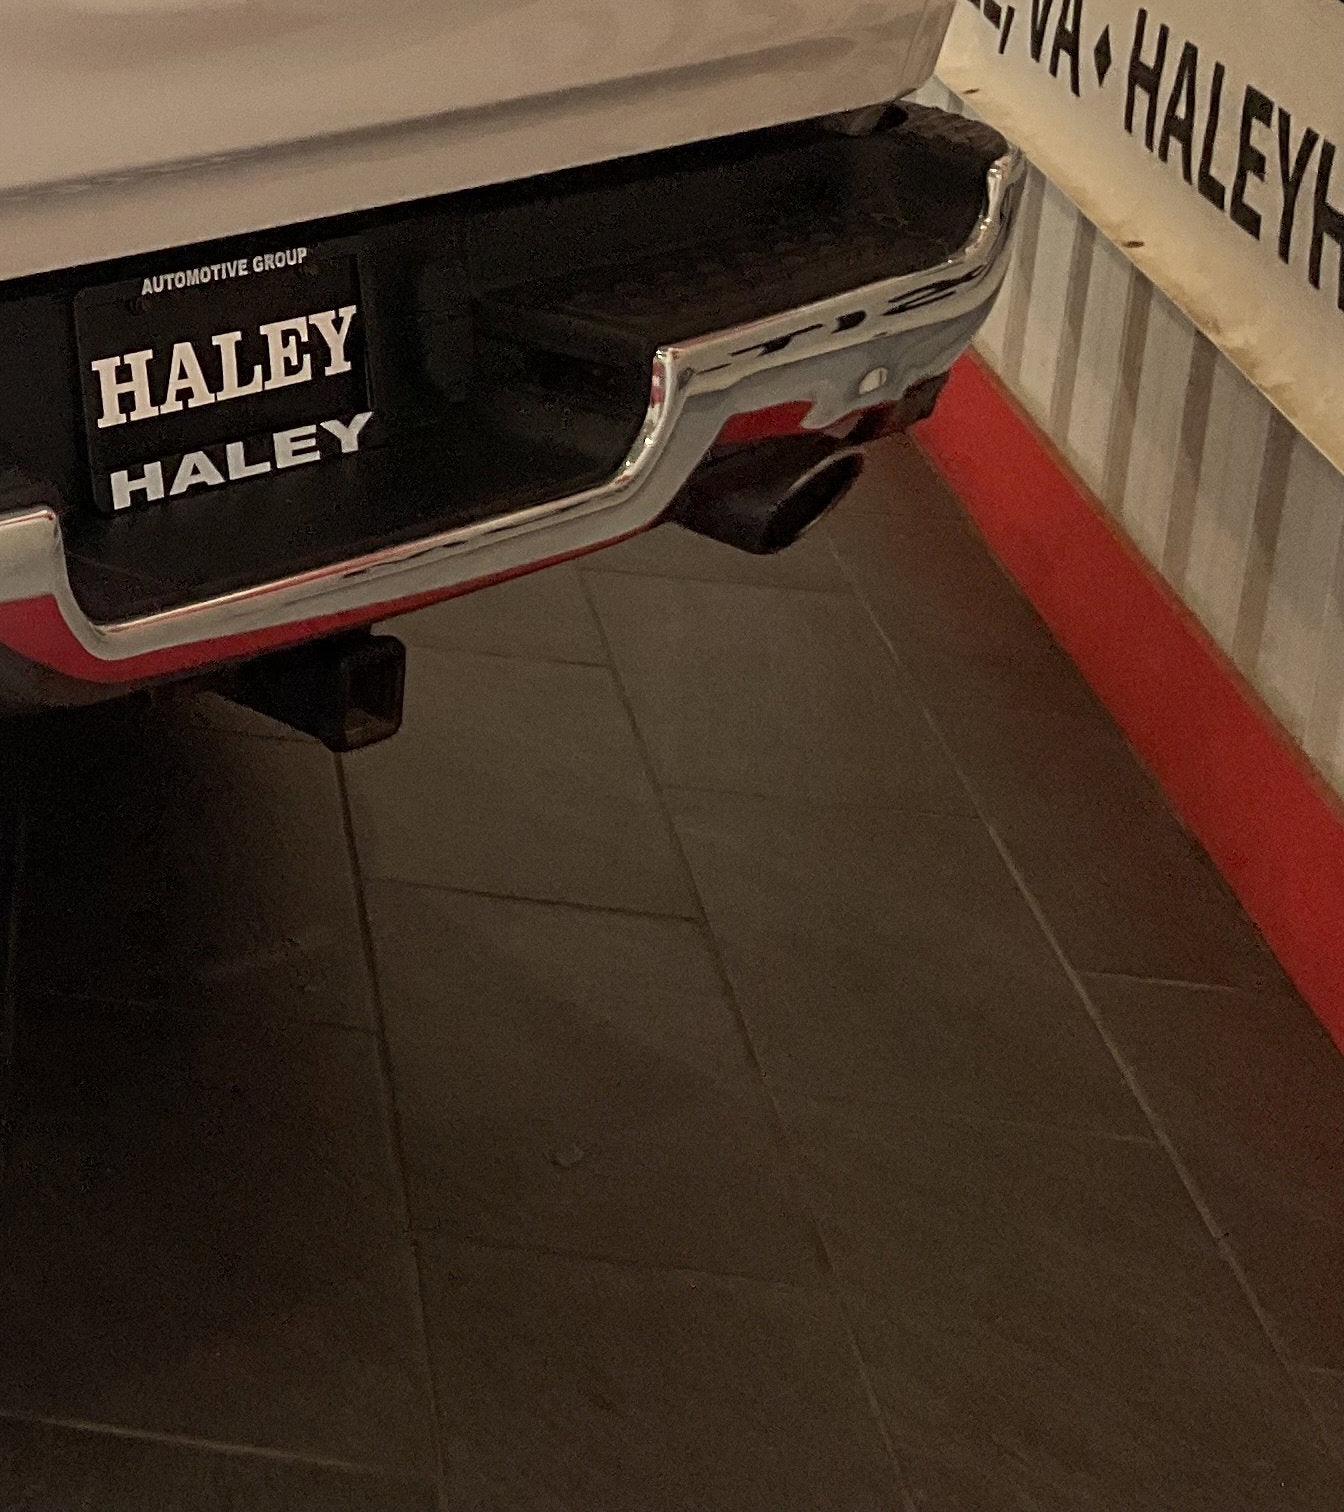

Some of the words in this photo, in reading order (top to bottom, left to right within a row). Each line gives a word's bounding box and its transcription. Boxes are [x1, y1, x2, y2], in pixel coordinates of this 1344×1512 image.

[141, 259, 248, 296] AUTOMOTIVE
[252, 247, 307, 273] GROUP
[91, 305, 357, 428] HALEY
[110, 411, 374, 510] HALEY
